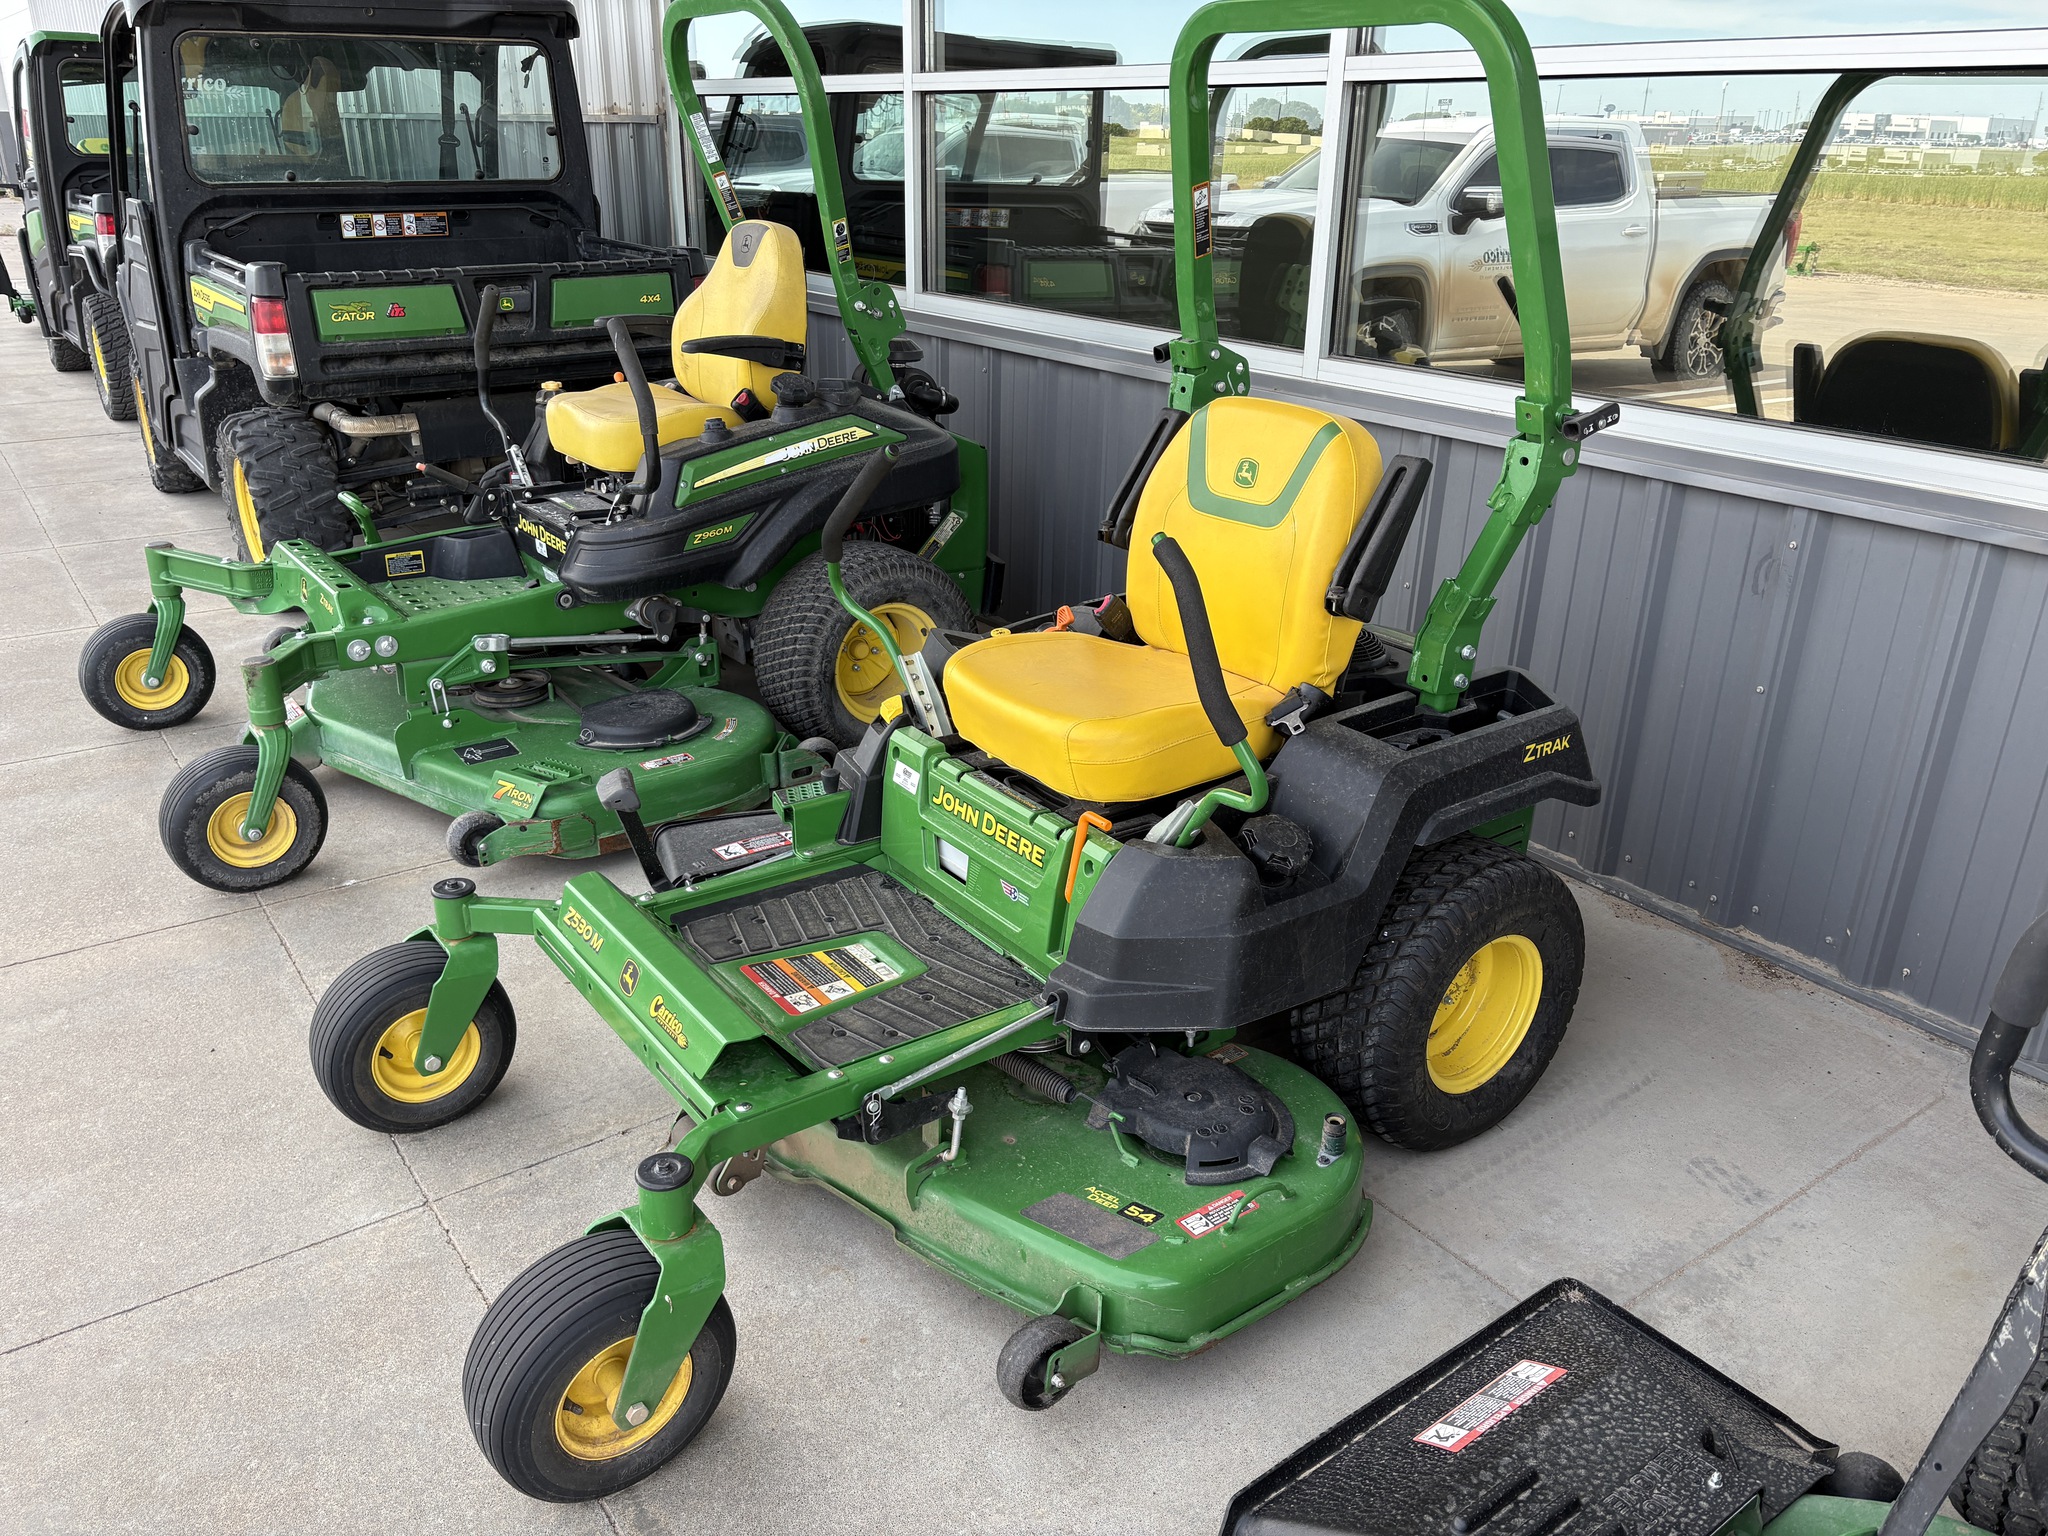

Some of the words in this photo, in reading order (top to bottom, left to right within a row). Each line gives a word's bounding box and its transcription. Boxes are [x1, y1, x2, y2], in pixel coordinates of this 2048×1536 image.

[181, 74, 227, 91] rrico
[331, 310, 376, 322] GATOR
[782, 441, 815, 461] JN
[816, 430, 858, 449] DEERE
[517, 513, 540, 539] JOHN
[539, 524, 568, 555] DEERE
[693, 524, 733, 545] Z960M
[1523, 733, 1572, 764] ZTRAK
[932, 784, 980, 828] JOHN
[980, 810, 1046, 869] DEERE
[650, 994, 684, 1035] Carrico
[1084, 1186, 1120, 1205] ACCEL
[1086, 1193, 1120, 1210] DEEP
[1123, 1205, 1157, 1224] 54
